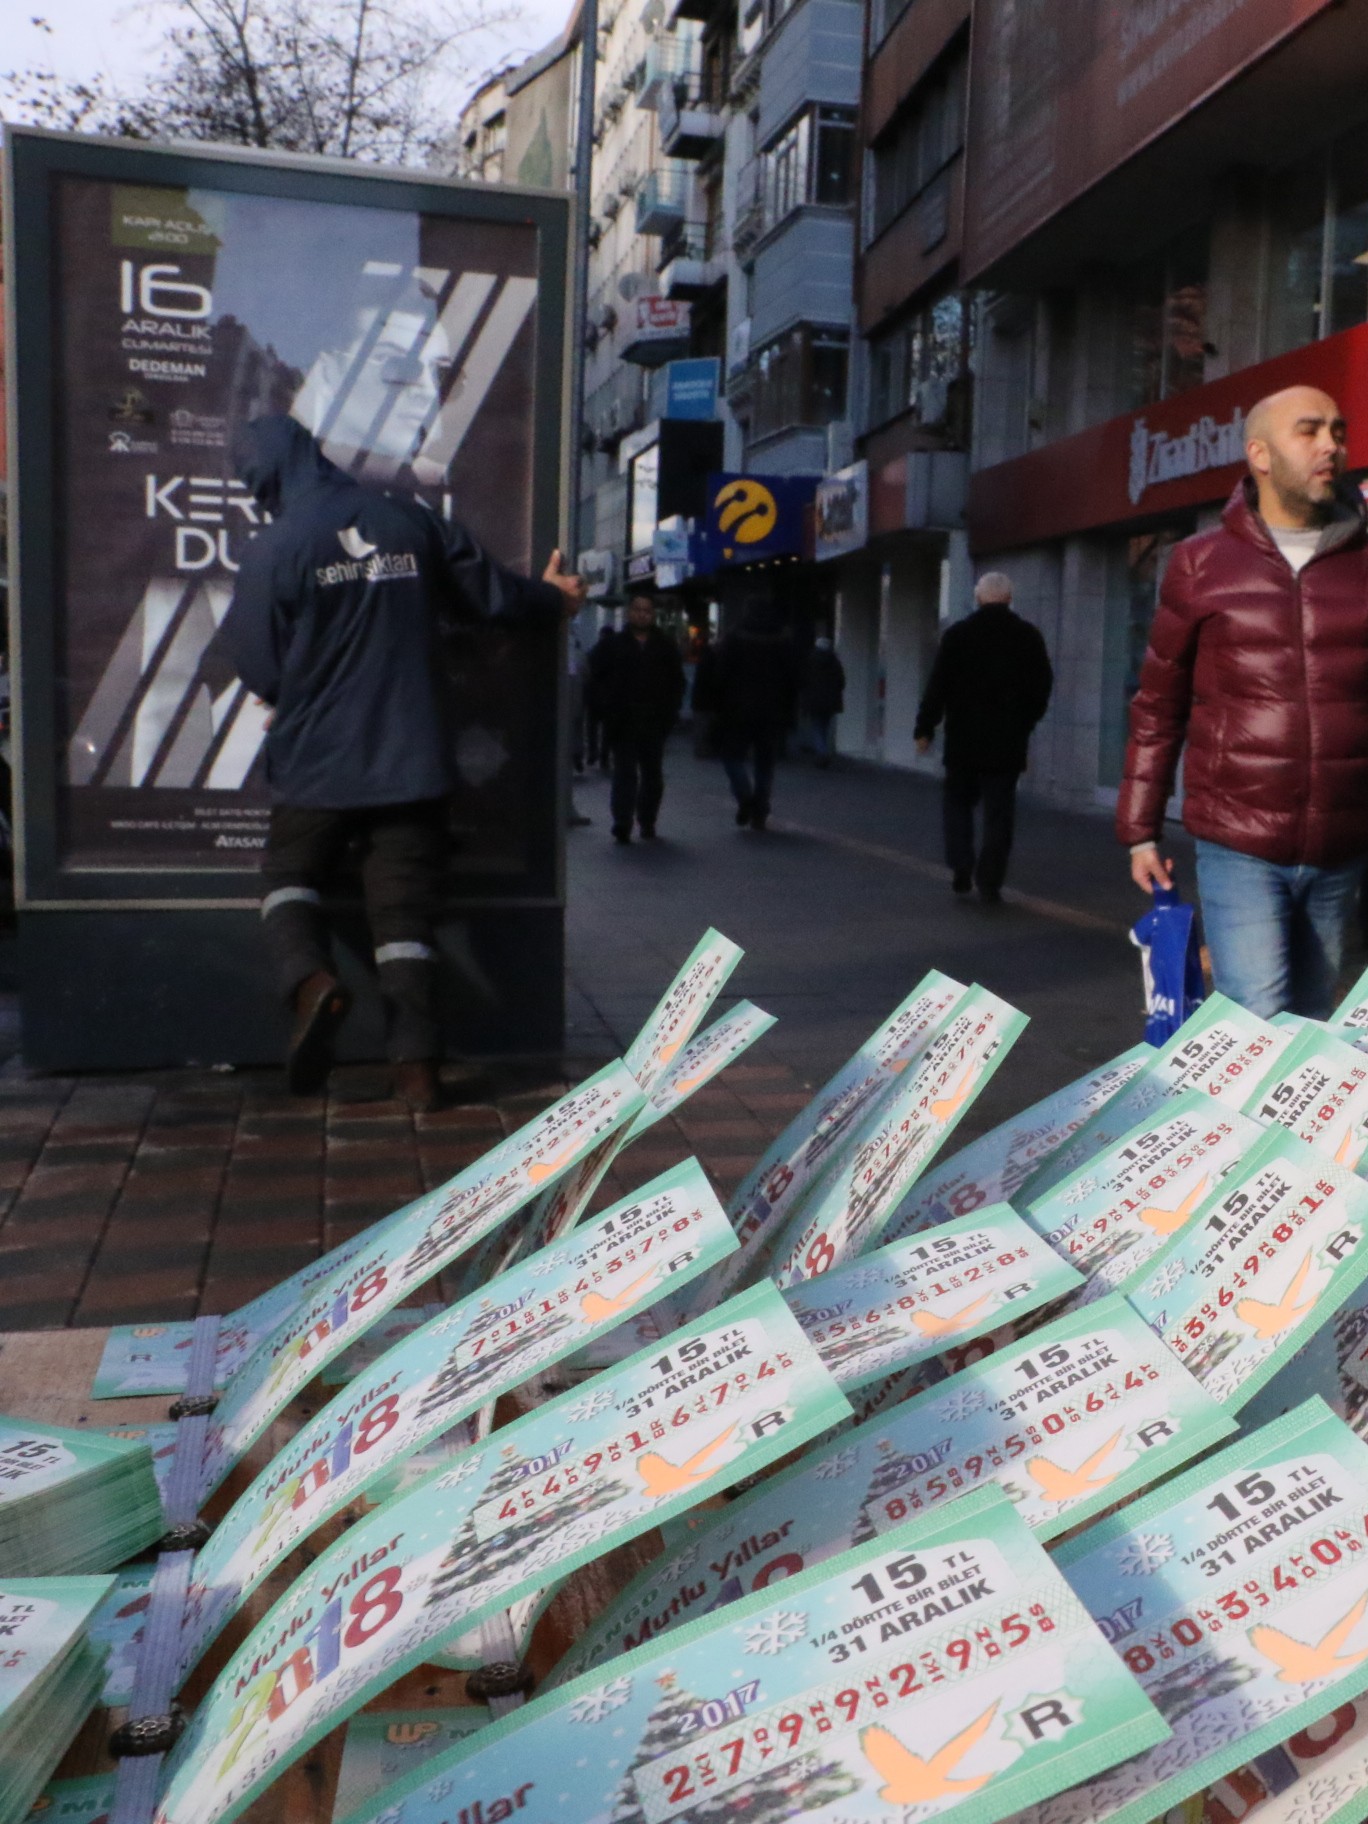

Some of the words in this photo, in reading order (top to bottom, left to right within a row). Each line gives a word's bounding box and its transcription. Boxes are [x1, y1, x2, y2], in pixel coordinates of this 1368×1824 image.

[120, 258, 213, 320] 16
[121, 319, 213, 340] ARALIK
[128, 358, 206, 376] DEDEMAN
[1169, 1041, 1205, 1069] 15
[1191, 1036, 1239, 1081] ARALIK
[1259, 1082, 1296, 1122] 15
[1112, 1176, 1136, 1193] 31
[1138, 1125, 1198, 1175] ARALIK
[1118, 1132, 1161, 1162] 15
[1204, 1190, 1250, 1233] 15
[1256, 1170, 1276, 1188] TL
[1256, 1174, 1282, 1208] BİLET
[577, 1252, 598, 1269] 31
[607, 1208, 675, 1252] ARALIK
[598, 1205, 642, 1234] 15
[1200, 1254, 1225, 1279] 31
[1227, 1181, 1293, 1252] ARALIK
[895, 1272, 919, 1288] 31
[925, 1243, 997, 1276] ARALIK
[910, 1237, 957, 1261] 15
[650, 1338, 707, 1376] 15
[719, 1327, 744, 1343] TL
[712, 1336, 747, 1358] BİLET
[1014, 1344, 1071, 1380] 15
[1080, 1337, 1106, 1351] TL
[1077, 1346, 1111, 1368] BİLET
[336, 1371, 404, 1427] Yıllar
[626, 1397, 655, 1419] 31
[663, 1346, 753, 1399] ARALIK
[999, 1399, 1028, 1421] 31
[1036, 1354, 1118, 1404] ARALIK
[509, 1438, 575, 1483] 2017
[1206, 1472, 1277, 1523] 15
[1287, 1465, 1318, 1482] TL
[1207, 1515, 1262, 1554] DÖRTTE
[1260, 1497, 1289, 1520] BİR
[1289, 1474, 1328, 1504] BİLET
[709, 1519, 795, 1582] Yıllar
[1201, 1551, 1236, 1578] 31
[1244, 1486, 1345, 1556] ARALIK
[841, 1603, 904, 1636] DÖRTTE
[907, 1585, 937, 1606] BİR
[938, 1564, 982, 1591] BİLET
[851, 1554, 928, 1605] 15
[942, 1550, 976, 1569] TL
[233, 1606, 315, 1699] Mutlu
[320, 1532, 406, 1602] Yıllar
[829, 1638, 868, 1664] 31
[880, 1577, 997, 1644] ARALIK
[675, 1678, 762, 1736] 2017
